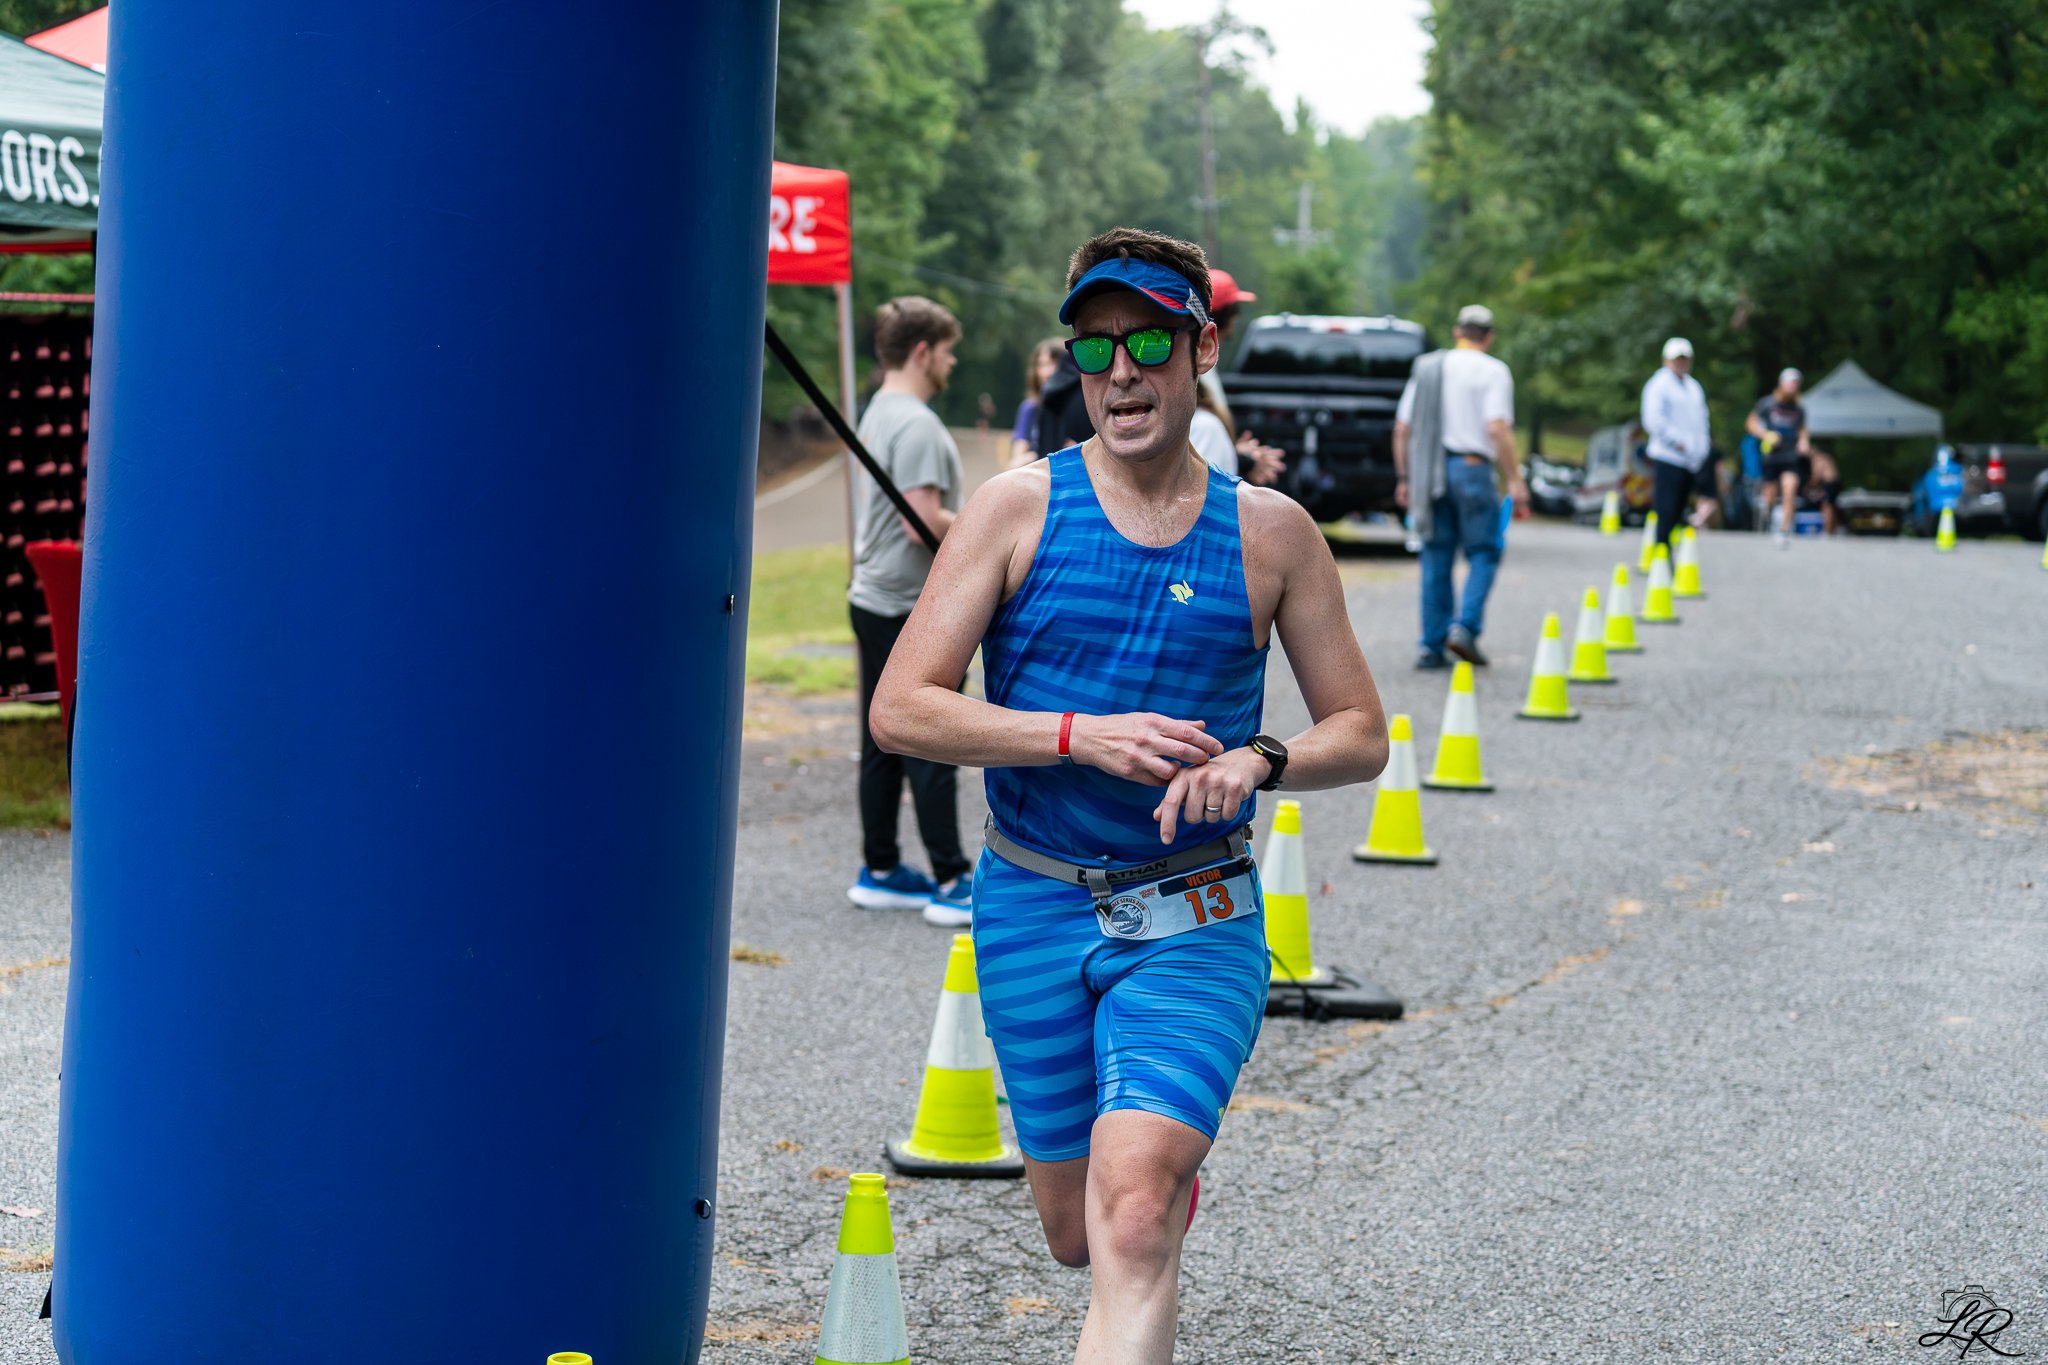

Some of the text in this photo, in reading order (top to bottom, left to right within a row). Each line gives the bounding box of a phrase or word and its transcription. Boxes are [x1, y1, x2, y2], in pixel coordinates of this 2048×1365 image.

[0, 130, 102, 208] ORS.
[769, 195, 818, 253] RE
[1106, 860, 1168, 880] ATHAN
[1185, 868, 1222, 887] VICTOR
[1184, 884, 1234, 925] 13
